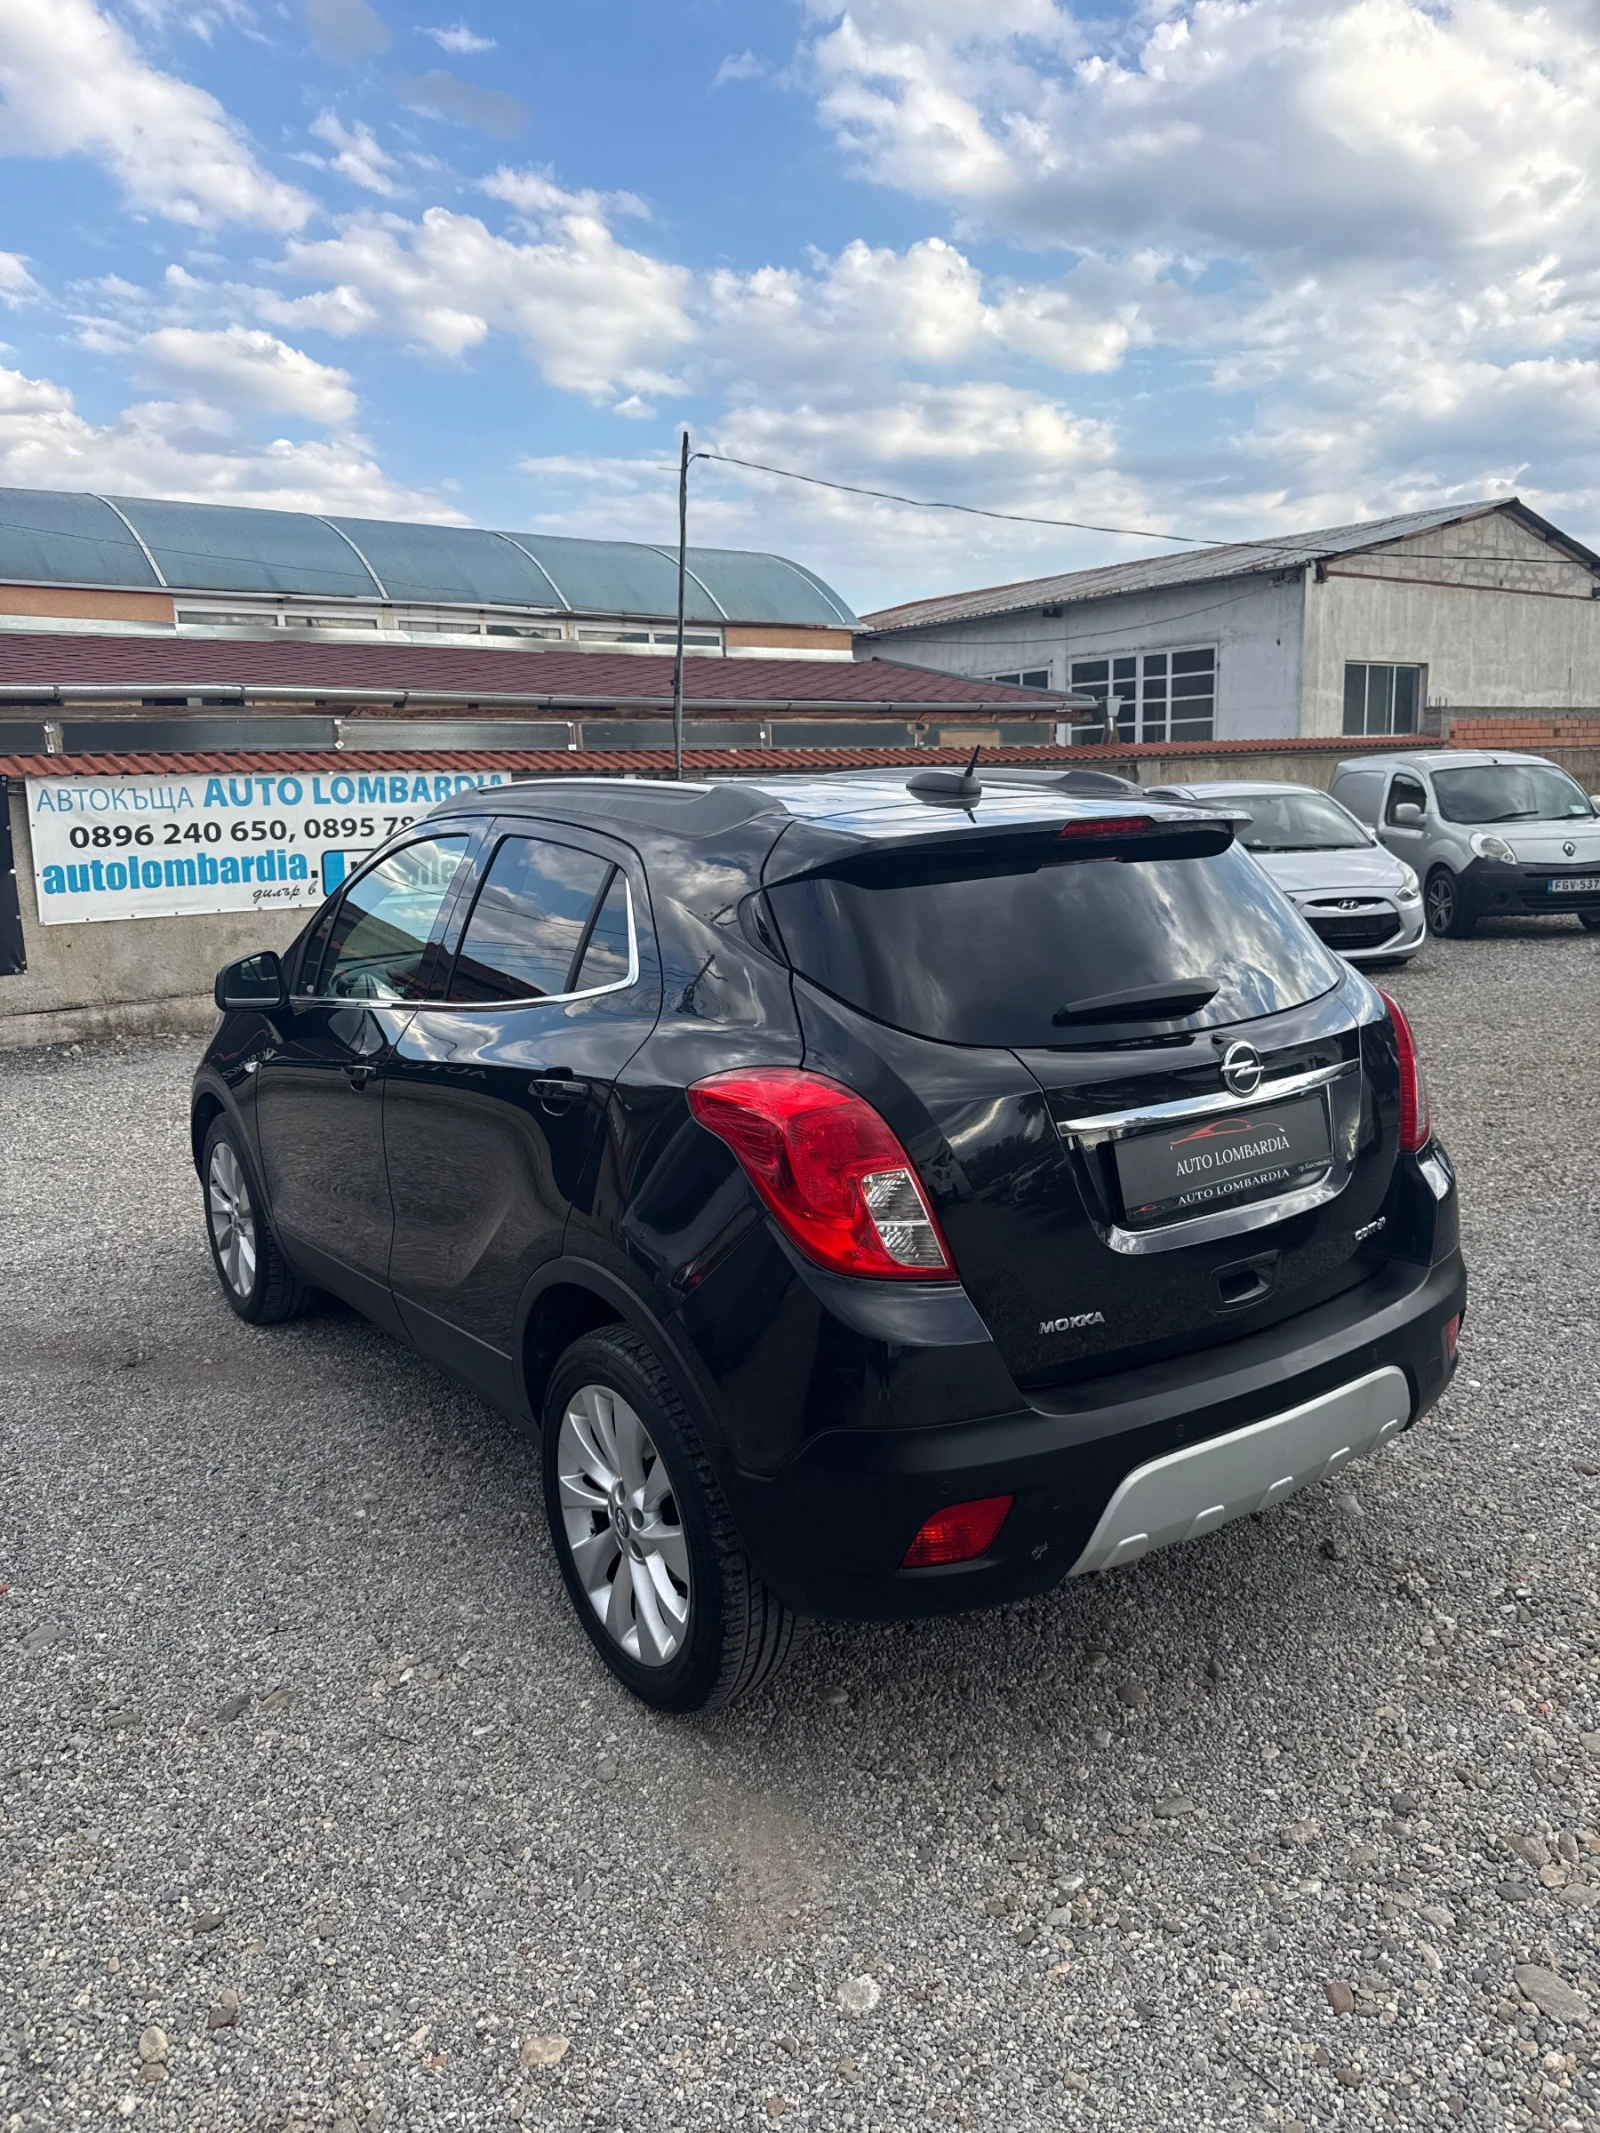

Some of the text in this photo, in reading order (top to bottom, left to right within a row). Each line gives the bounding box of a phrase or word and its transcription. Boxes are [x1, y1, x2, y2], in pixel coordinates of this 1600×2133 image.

[36, 786, 195, 813] АВТОКЪЩА
[203, 777, 304, 808] AUTO
[69, 824, 154, 848] 0896
[163, 821, 222, 844] 240
[230, 819, 296, 843] 650,
[304, 816, 375, 839] 0895
[252, 884, 301, 904] дилър
[1580, 879, 1600, 889] 537
[1176, 1135, 1291, 1177] AUTO LOMBARDIA
[1177, 1167, 1291, 1206] AUTO LOMBARDIA
[1039, 1311, 1106, 1335] MOKKA
